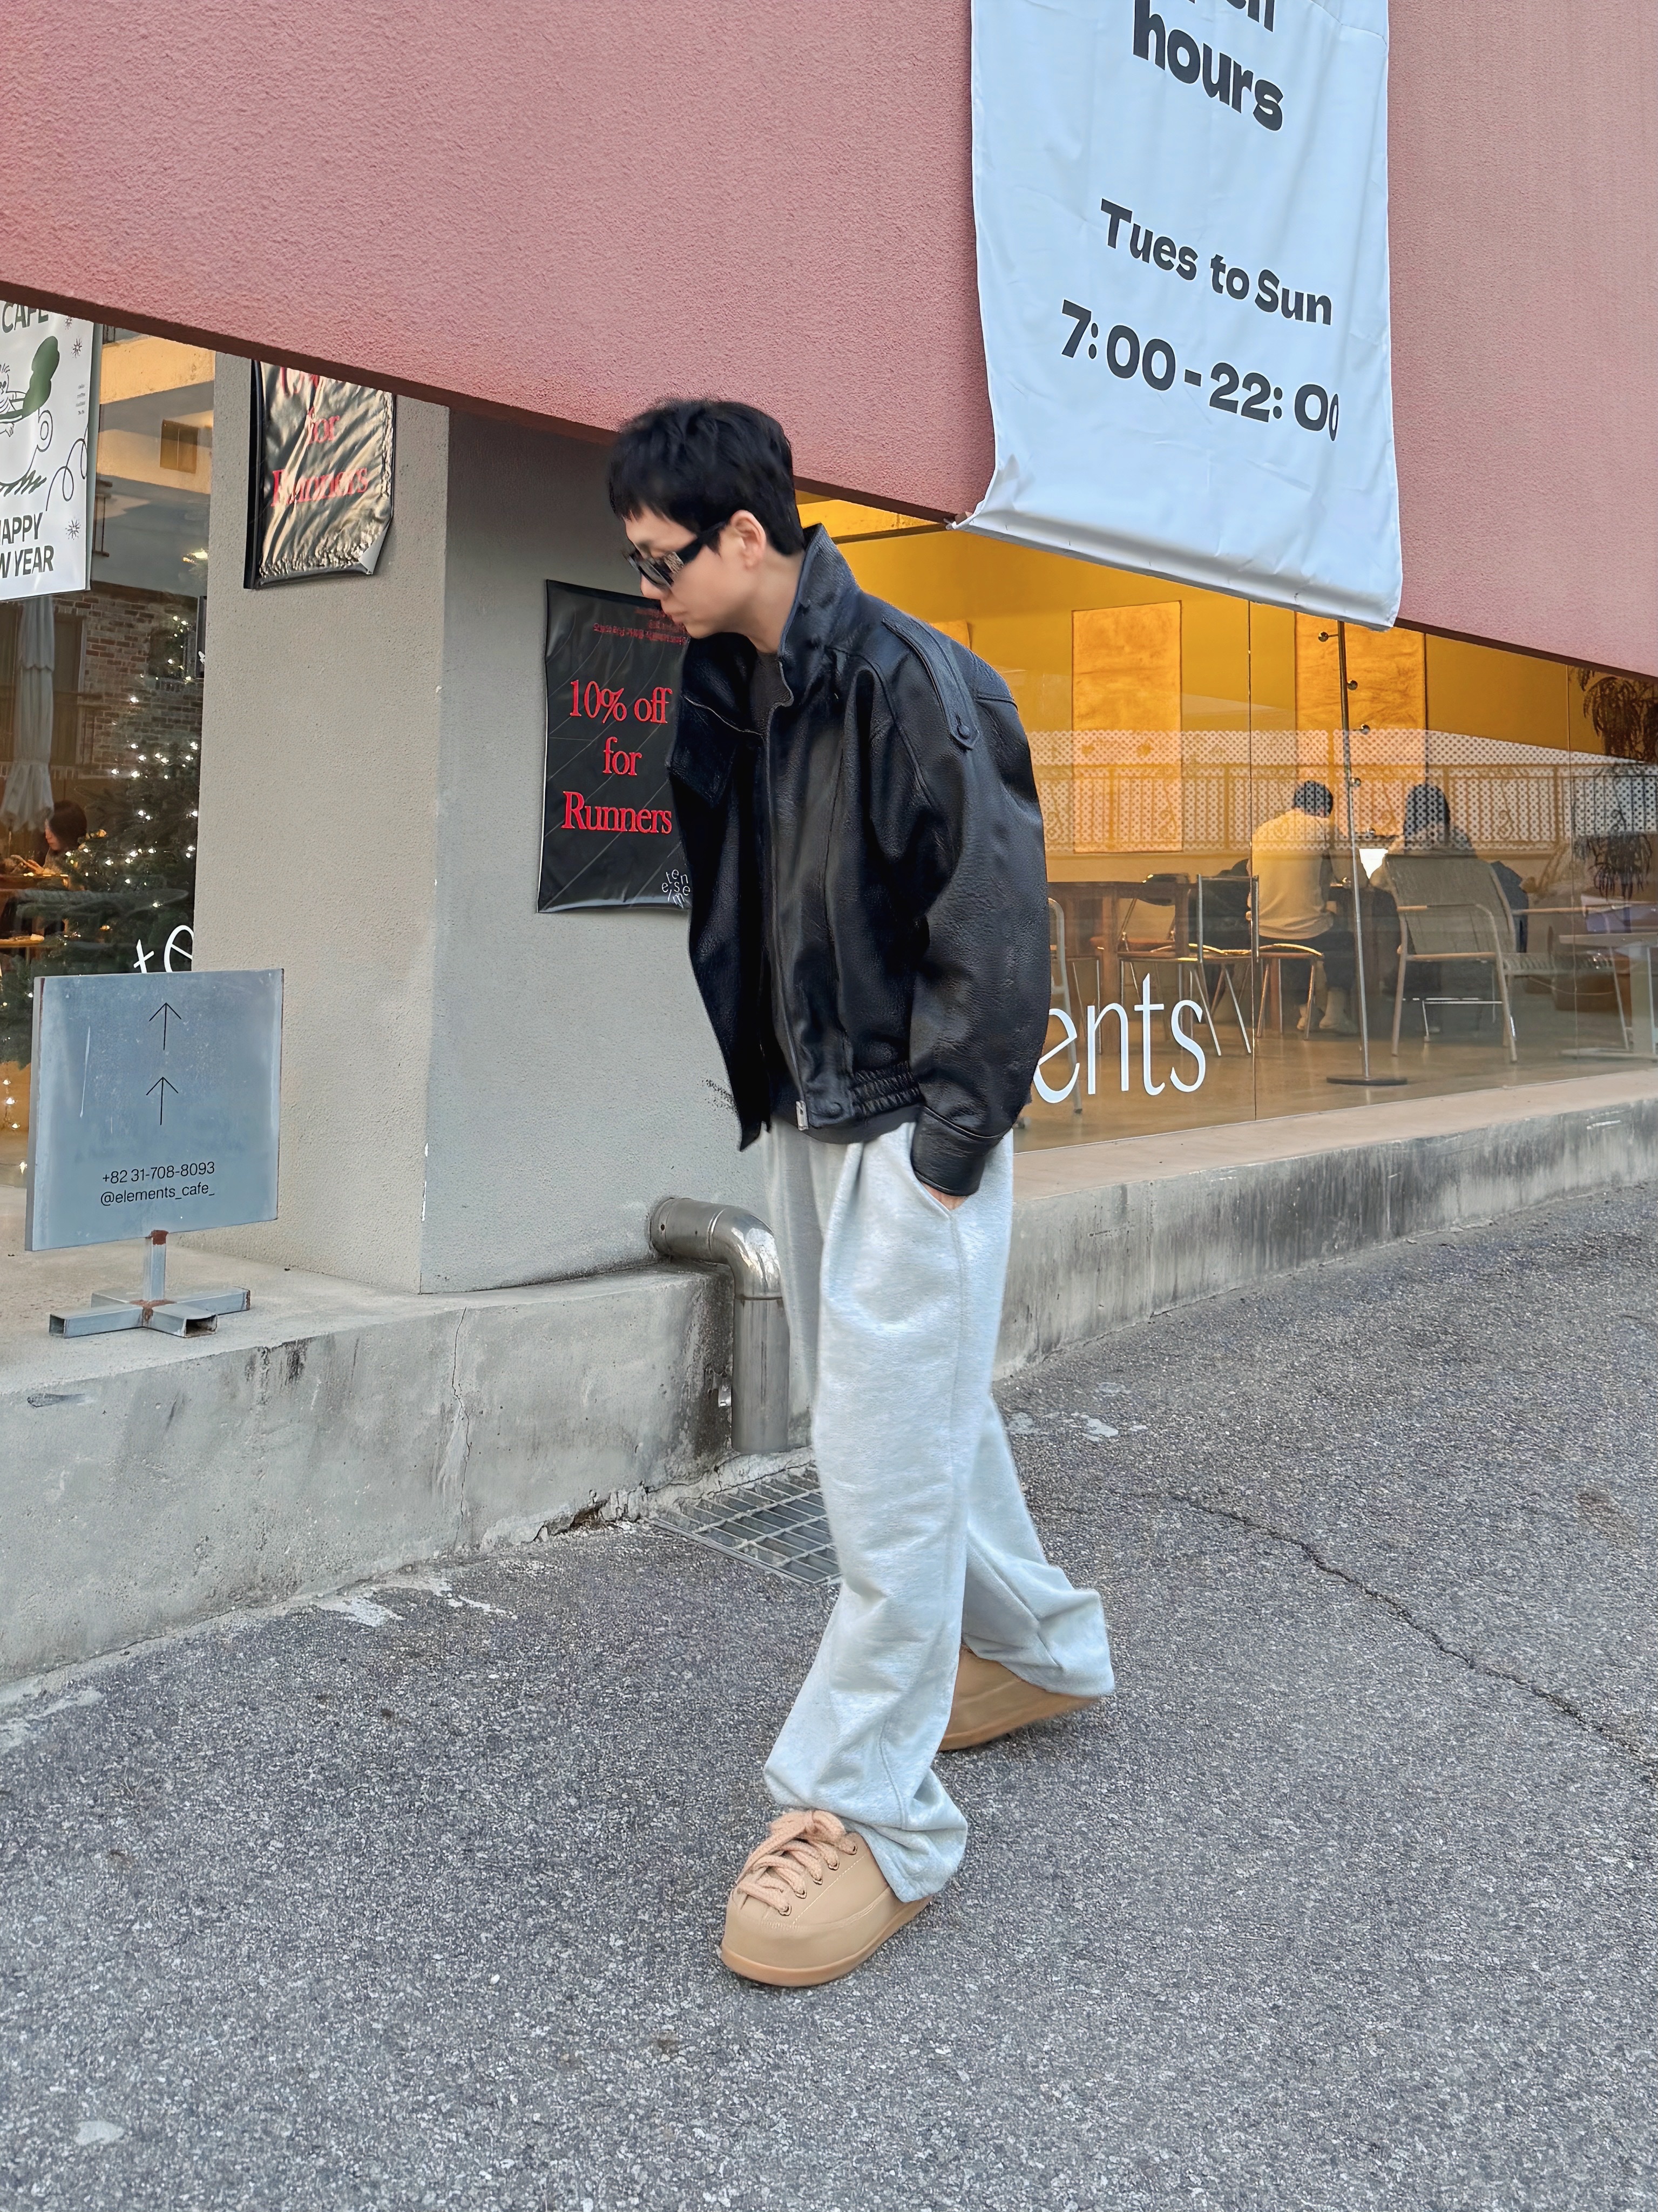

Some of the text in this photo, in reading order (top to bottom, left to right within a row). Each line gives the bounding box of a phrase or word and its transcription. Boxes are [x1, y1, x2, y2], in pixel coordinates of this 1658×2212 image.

[1133, 0, 1283, 131] hours
[1101, 198, 1332, 325] Tues to Sun
[0, 512, 43, 545] APPY
[15, 545, 55, 577] YEAR
[570, 679, 673, 724] 10% off
[602, 736, 642, 776] for
[560, 791, 672, 834] Runners
[103, 1161, 215, 1184] +82 31-708-8093
[100, 1181, 215, 1206] @elements_cafe_
